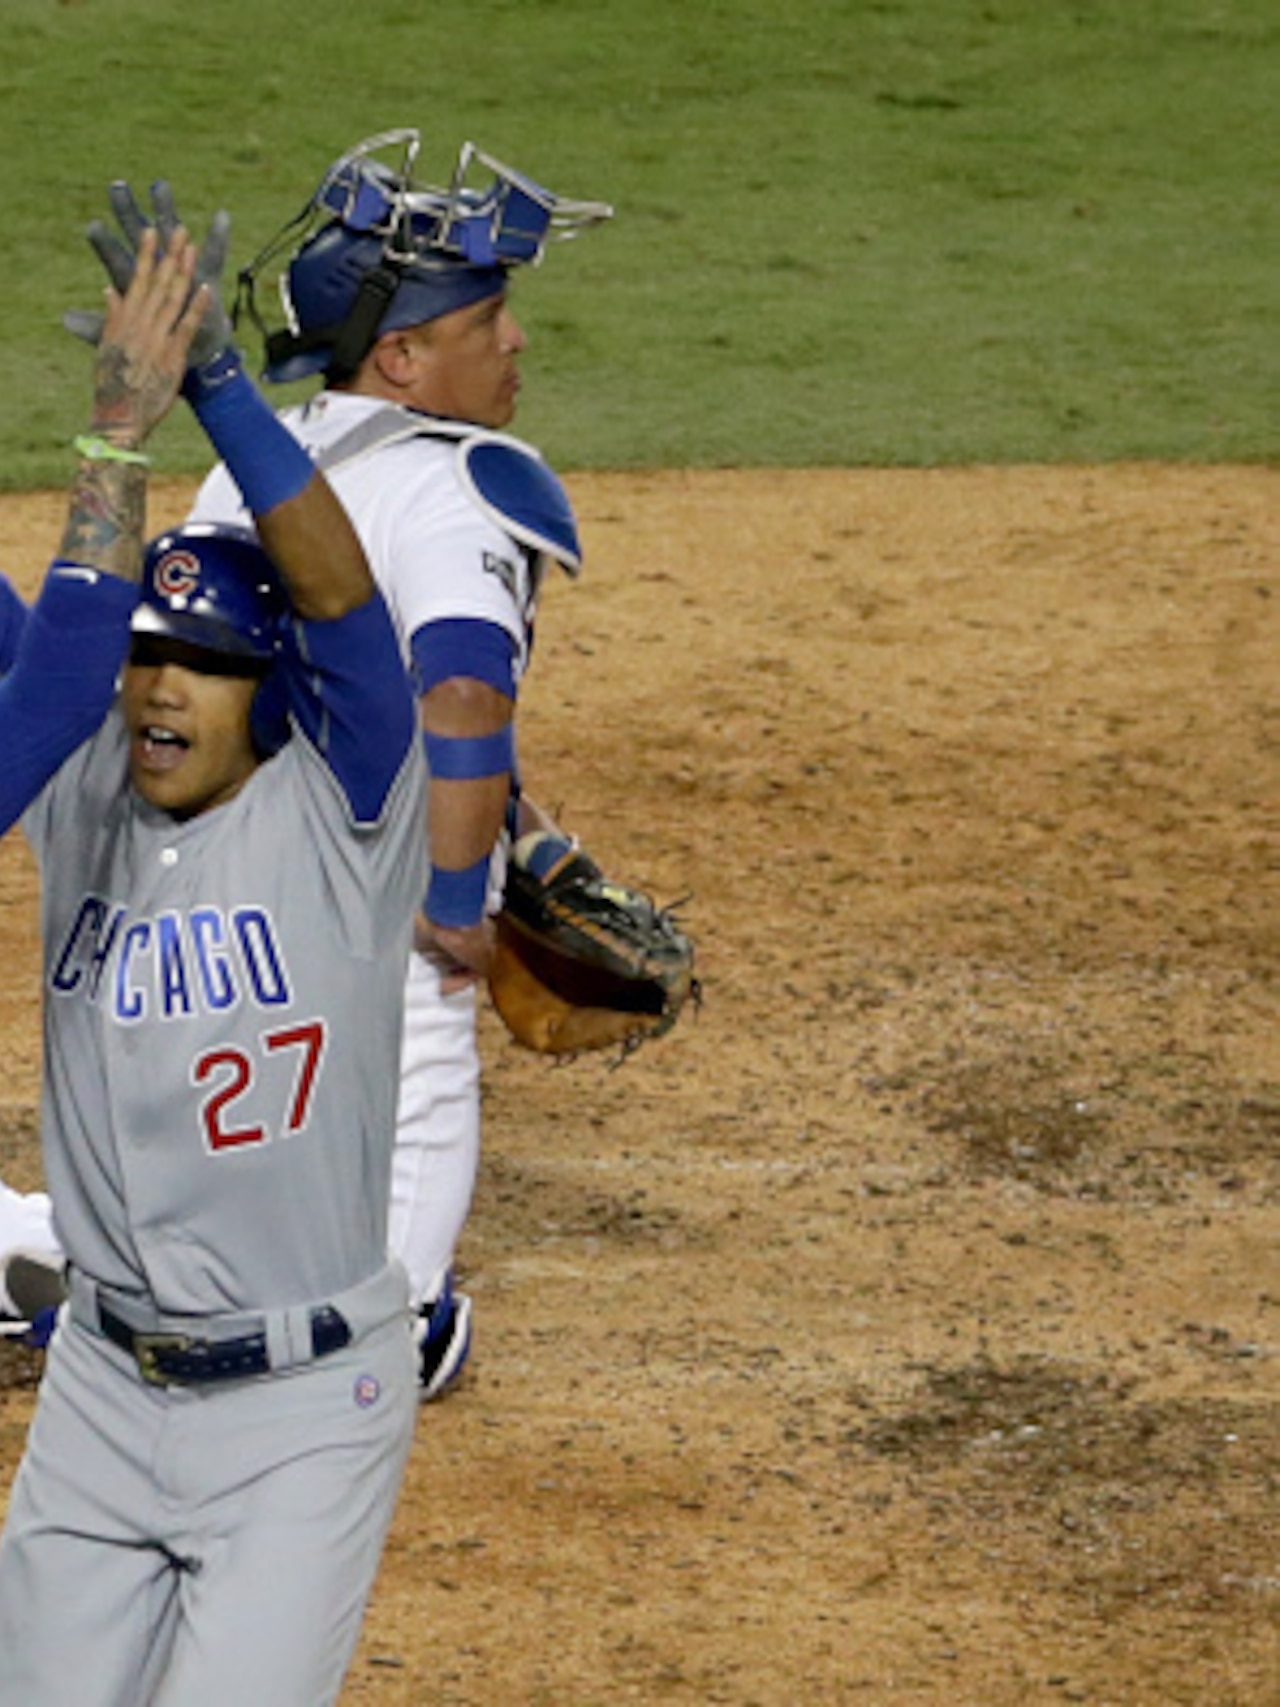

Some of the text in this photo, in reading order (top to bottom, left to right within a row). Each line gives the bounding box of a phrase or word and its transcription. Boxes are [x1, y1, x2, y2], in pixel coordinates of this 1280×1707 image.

[154, 551, 201, 597] C
[51, 895, 291, 1018] CHCAGO
[193, 1021, 325, 1153] 27
